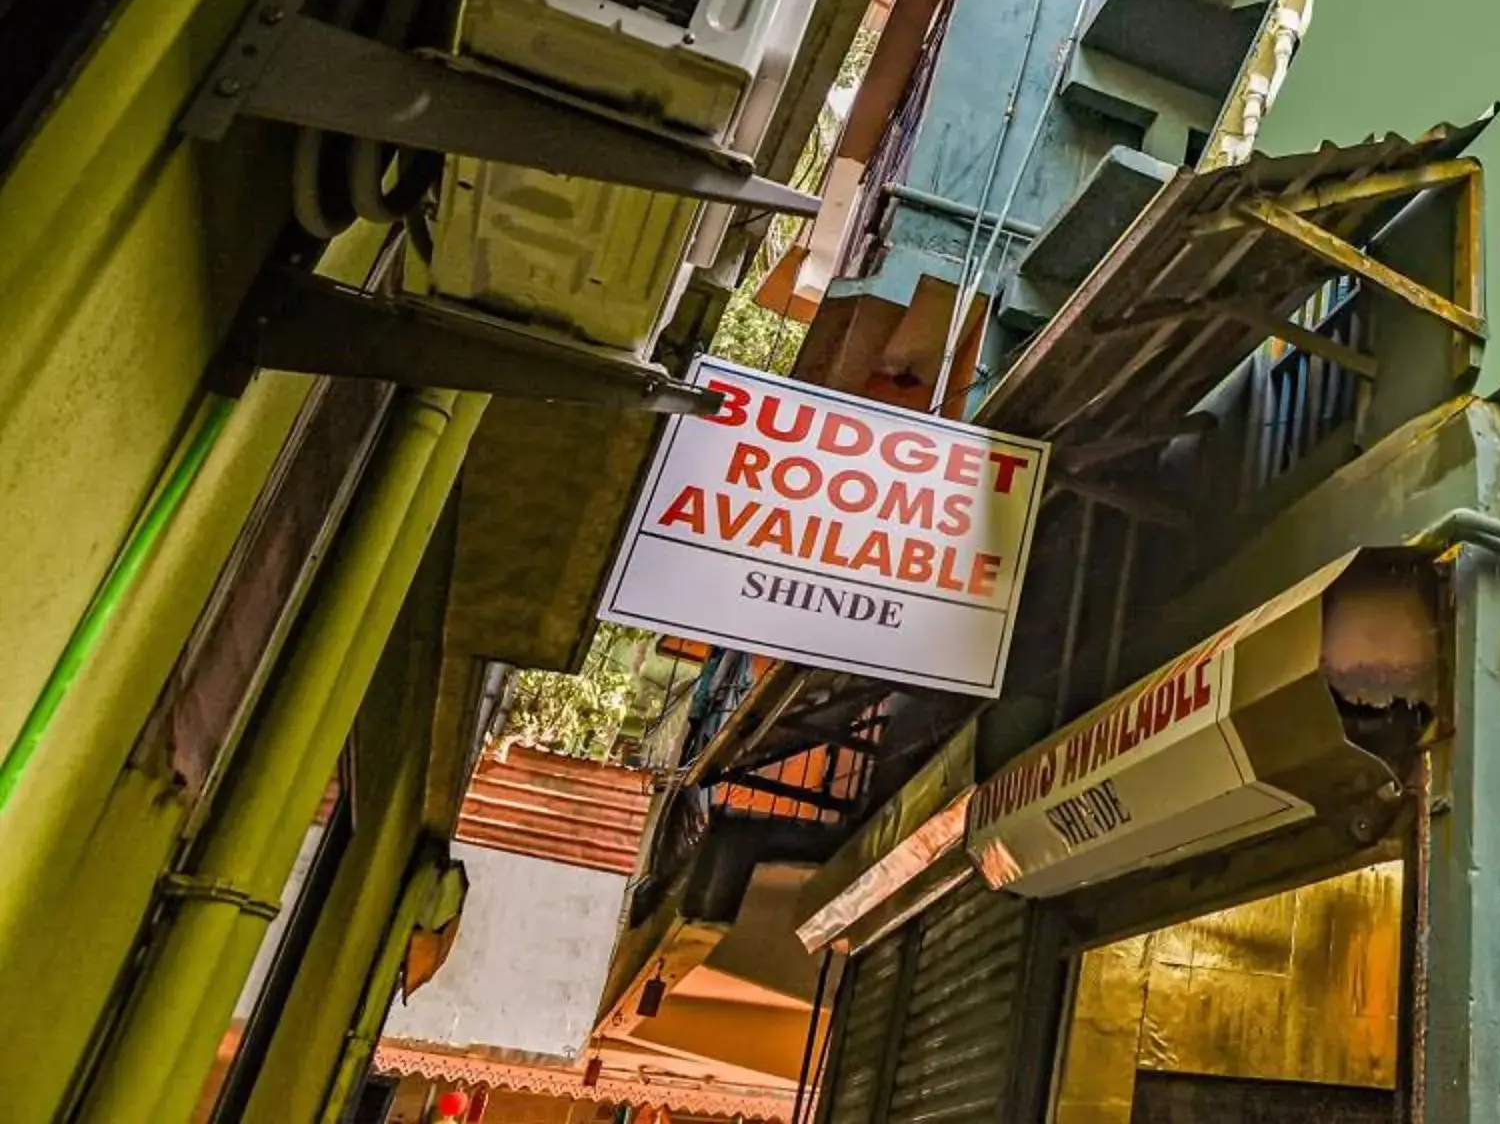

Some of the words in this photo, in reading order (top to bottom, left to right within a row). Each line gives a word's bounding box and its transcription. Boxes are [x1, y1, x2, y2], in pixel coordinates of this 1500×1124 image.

[702, 379, 1028, 493] BUDGET
[725, 442, 974, 537] ROOMS
[658, 486, 1002, 597] AVAILABLE
[741, 571, 904, 629] SHINDE
[1045, 777, 1131, 847] SHINDE
